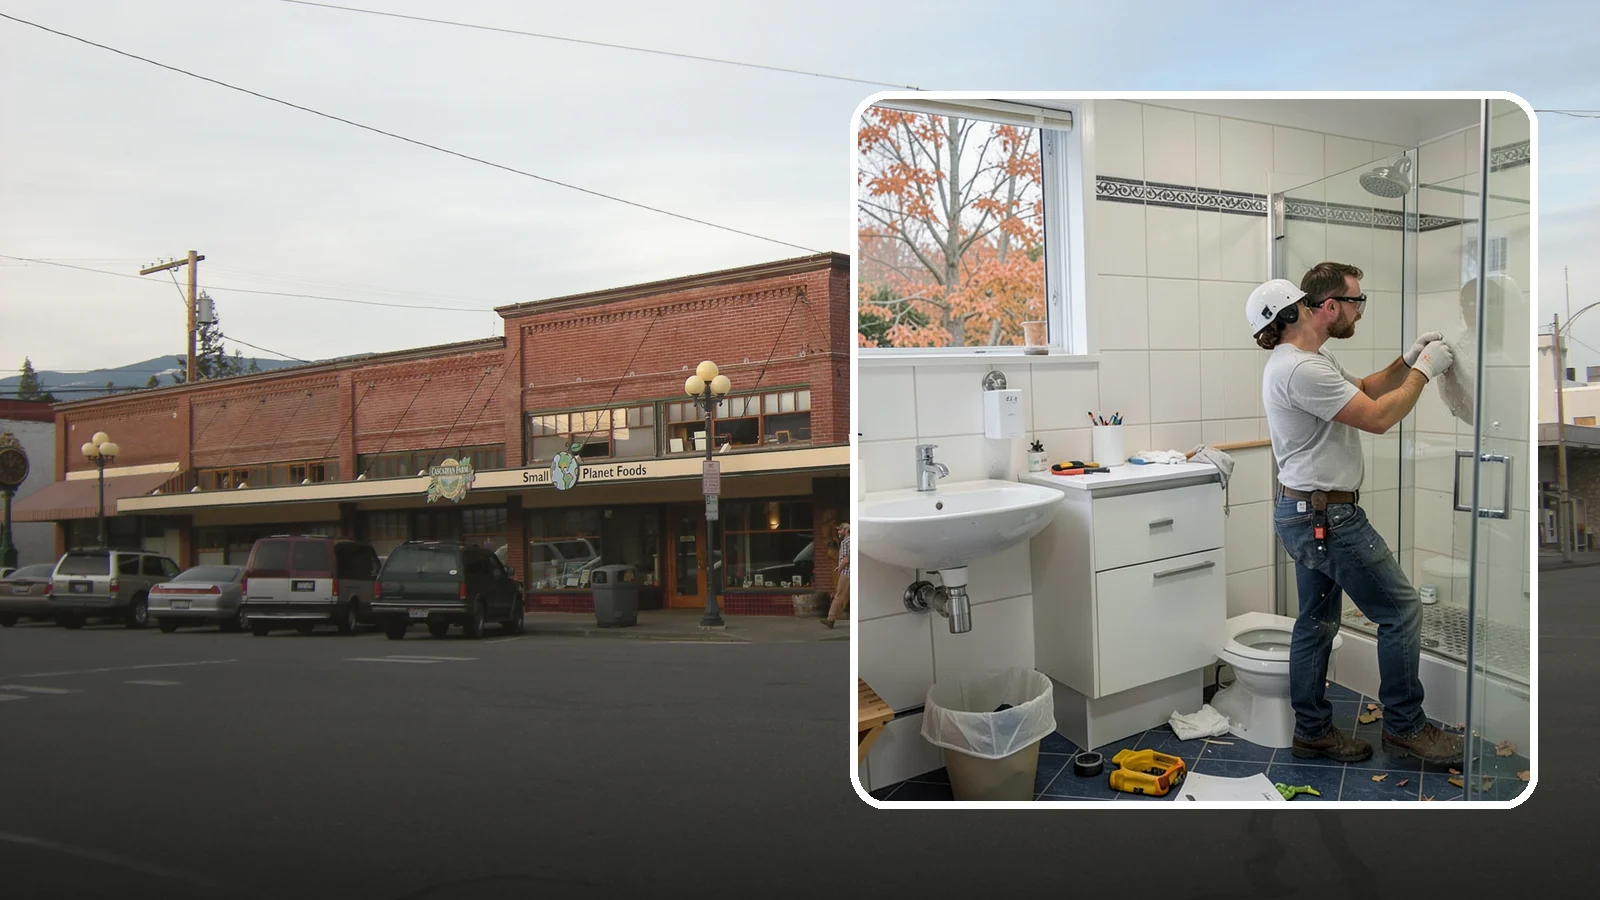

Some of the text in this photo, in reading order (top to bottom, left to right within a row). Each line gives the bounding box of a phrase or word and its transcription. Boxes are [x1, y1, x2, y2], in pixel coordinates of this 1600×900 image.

[523, 464, 647, 483] Small Planet Foods
